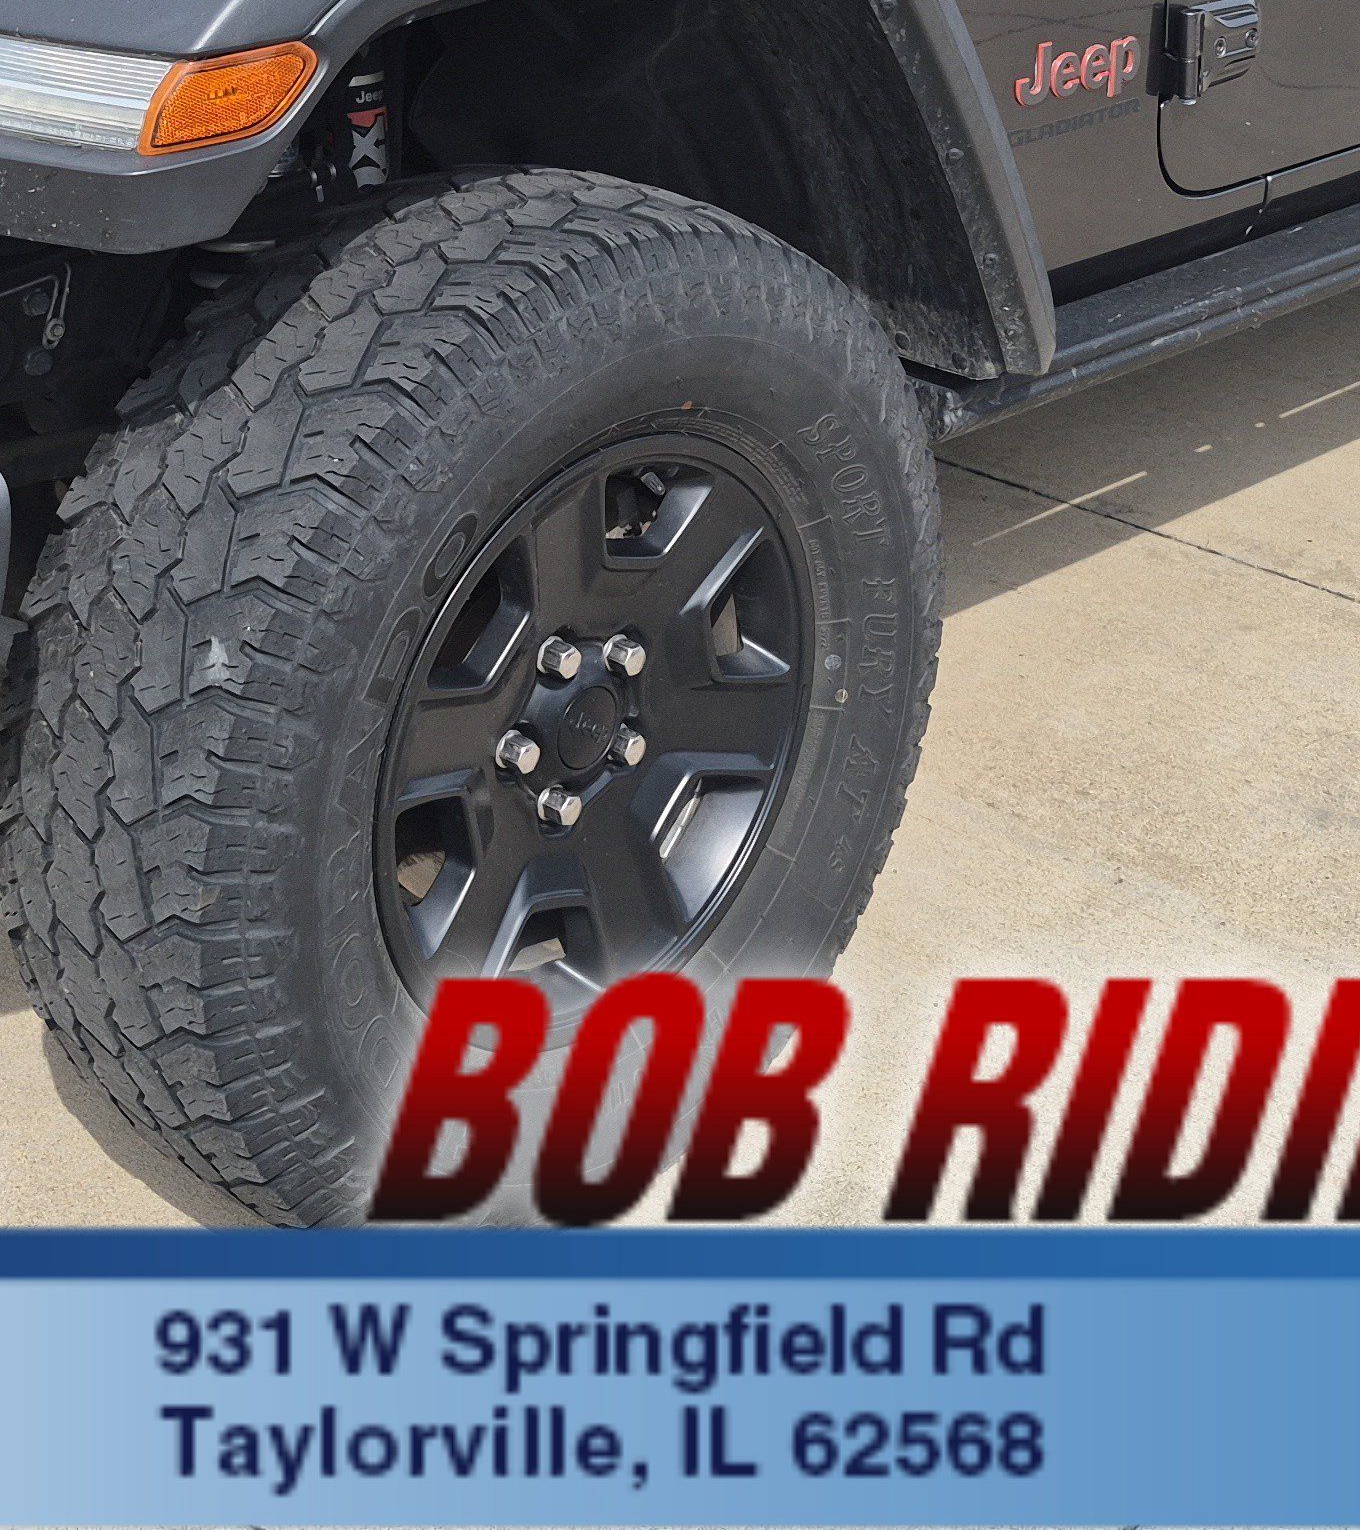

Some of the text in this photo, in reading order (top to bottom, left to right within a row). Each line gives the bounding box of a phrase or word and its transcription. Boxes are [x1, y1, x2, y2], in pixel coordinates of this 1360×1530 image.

[1014, 35, 1140, 106] Jeep
[797, 413, 890, 546] SPORT
[857, 577, 899, 726] FURY
